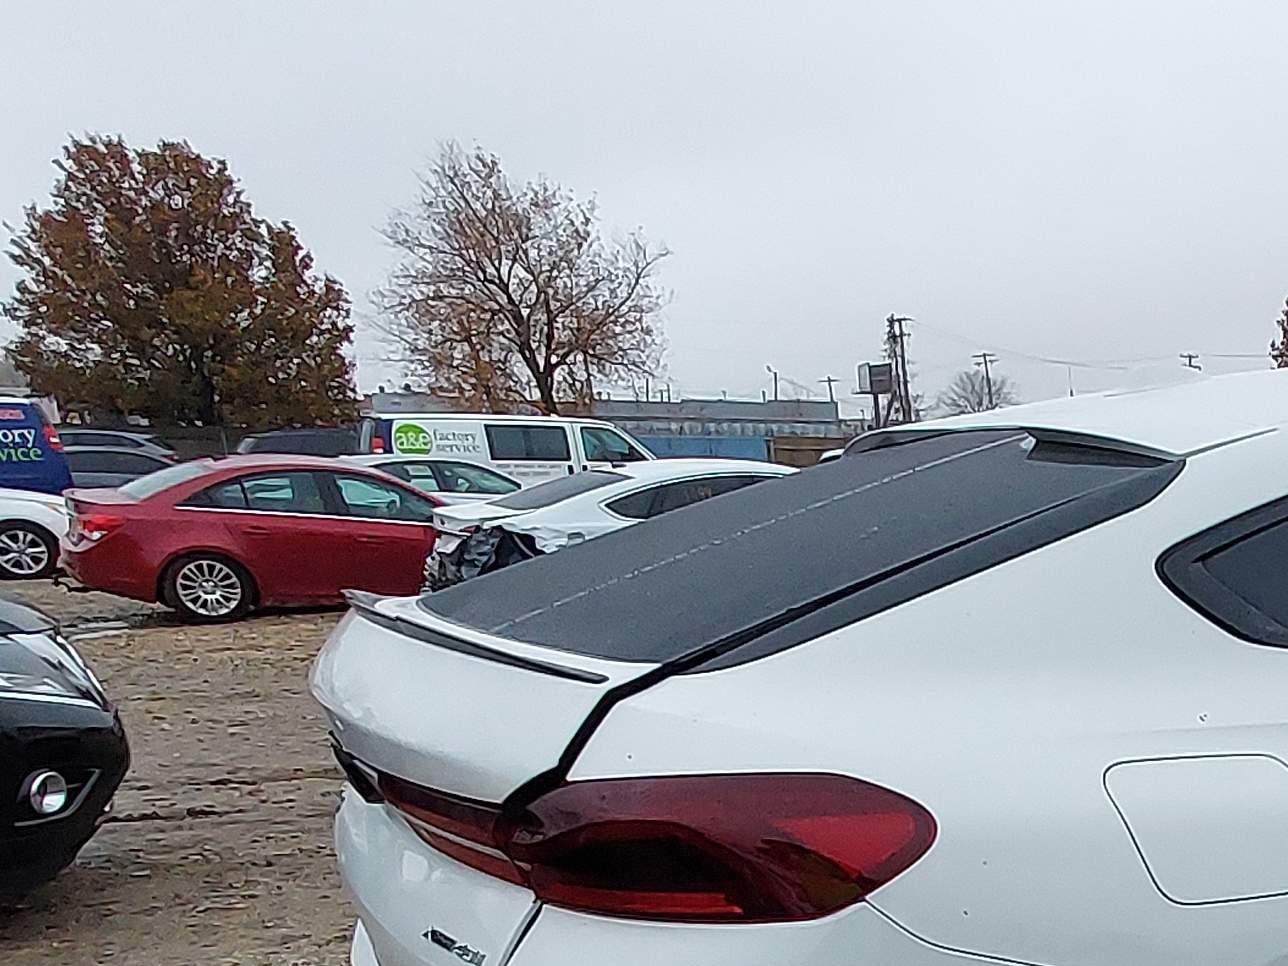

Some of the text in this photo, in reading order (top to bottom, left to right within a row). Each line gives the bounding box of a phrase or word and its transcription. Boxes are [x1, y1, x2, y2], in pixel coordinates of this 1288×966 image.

[396, 432, 432, 449] a&e
[433, 429, 476, 442] factory
[436, 443, 481, 453] service
